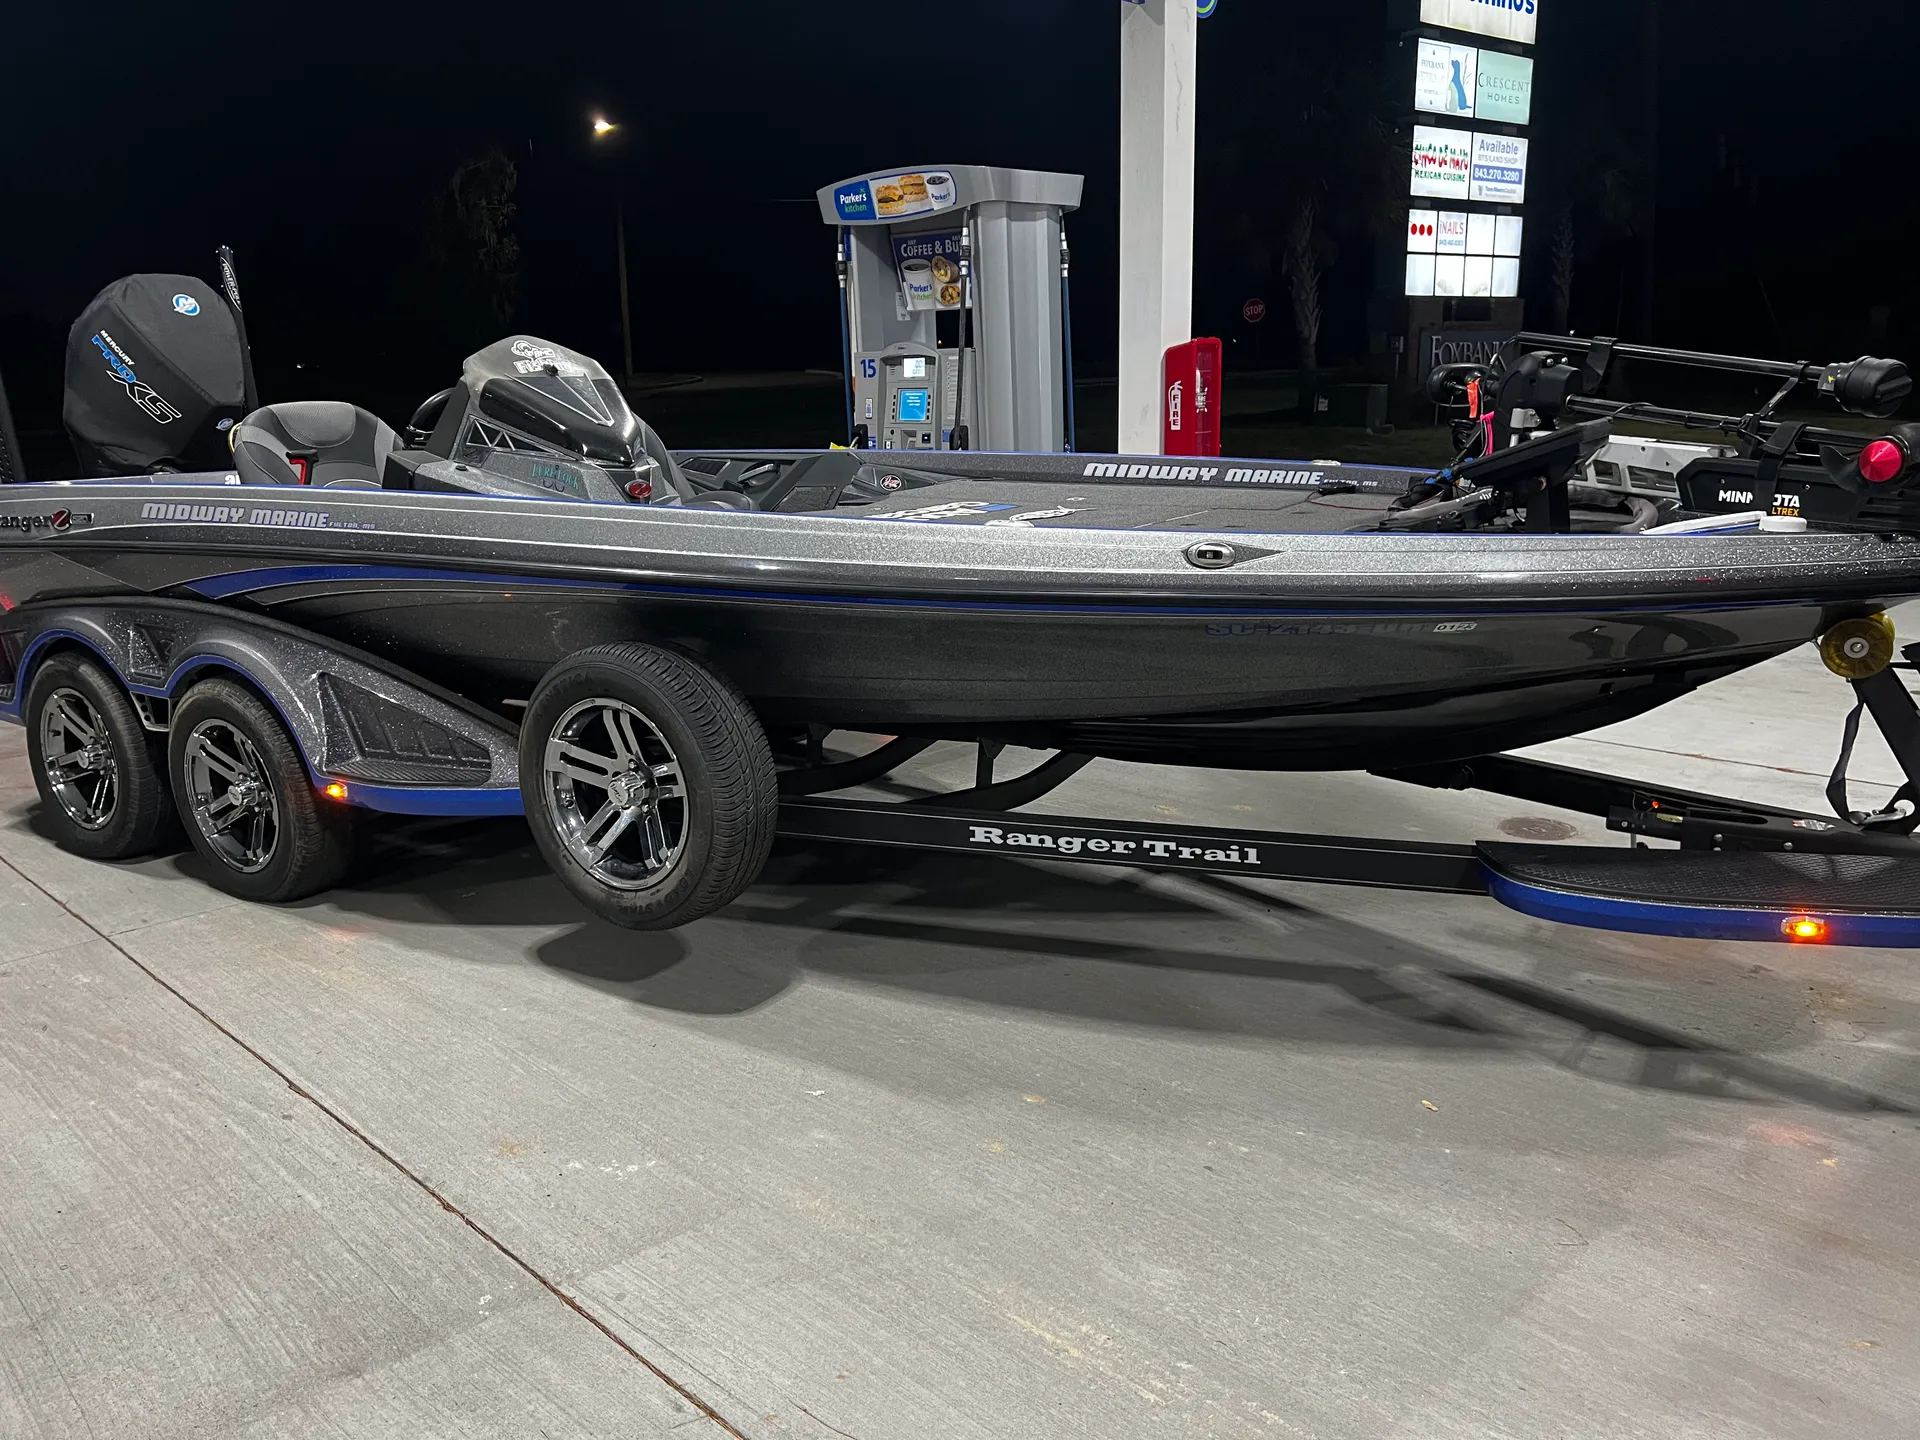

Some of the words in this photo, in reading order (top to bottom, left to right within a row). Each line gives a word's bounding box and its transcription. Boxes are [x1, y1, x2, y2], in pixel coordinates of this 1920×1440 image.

[1478, 72, 1530, 93] CRESCENT
[1487, 93, 1520, 104] HOMES
[1479, 139, 1519, 155] Available
[1414, 170, 1441, 180] MEXICAN
[1443, 173, 1466, 182] CUISINE
[840, 192, 867, 205] Parker's
[845, 203, 867, 213] kitchen
[1440, 220, 1464, 235] iNAILS
[901, 243, 933, 257] COFFEE
[935, 240, 943, 254] &
[1245, 304, 1264, 316] STOP
[100, 330, 135, 366] MERCURY
[860, 358, 877, 378] 15
[106, 369, 183, 424] XS
[1083, 462, 1218, 482] MIDWAY
[1224, 468, 1325, 486] MARINE
[141, 502, 245, 523] MIDWAY
[250, 508, 329, 528] MARINE
[329, 521, 360, 529] FULTON,
[1772, 506, 1800, 517] LTREX
[0, 513, 52, 532] anger
[969, 825, 1137, 854] Ranger
[1143, 839, 1261, 865] Trail
